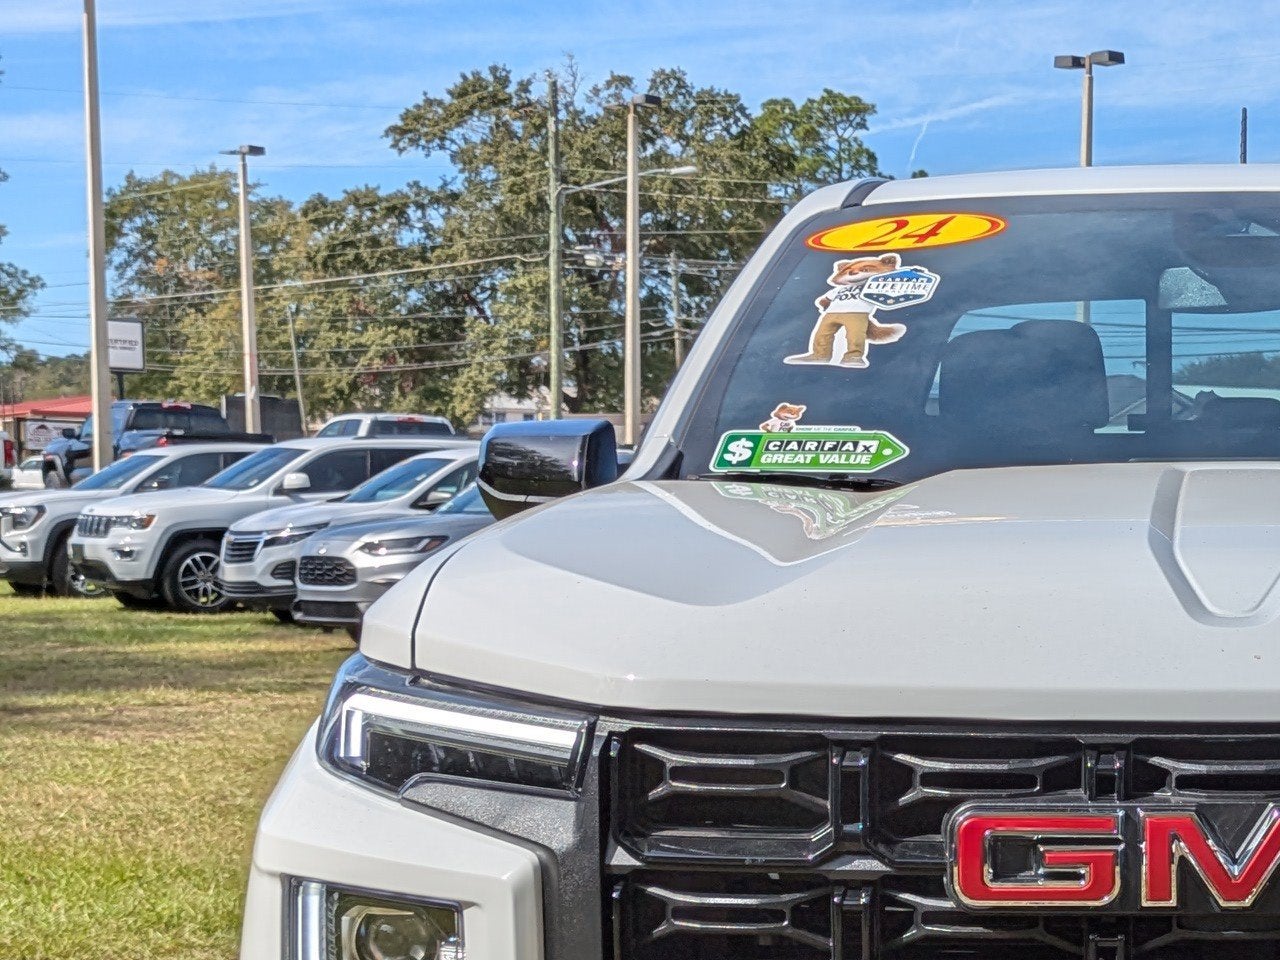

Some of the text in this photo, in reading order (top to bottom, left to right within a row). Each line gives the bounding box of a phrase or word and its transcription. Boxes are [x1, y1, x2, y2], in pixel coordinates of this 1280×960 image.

[853, 215, 957, 248] 24
[765, 440, 880, 454] CARFAX
[760, 454, 873, 465] GREAT VALUE
